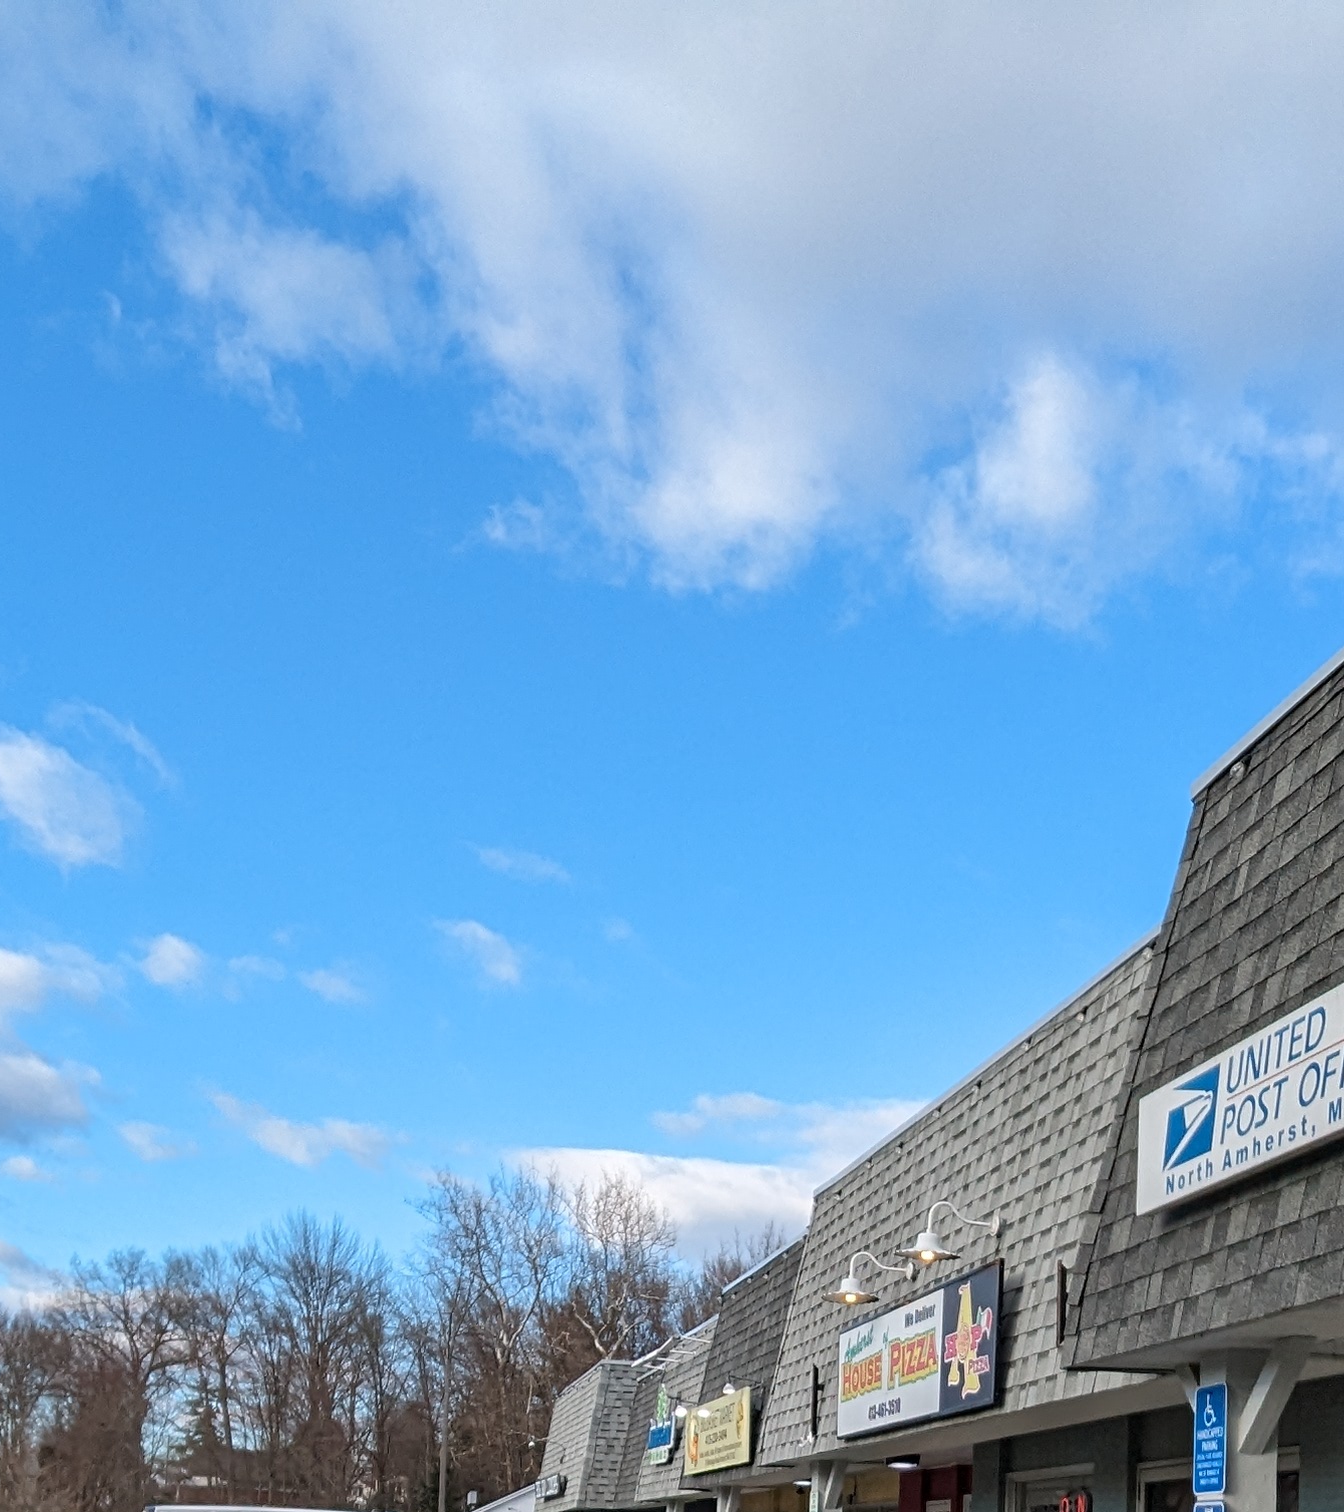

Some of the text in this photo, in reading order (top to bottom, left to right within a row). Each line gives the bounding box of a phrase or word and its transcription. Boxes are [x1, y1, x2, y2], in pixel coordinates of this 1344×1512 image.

[1225, 1006, 1326, 1093] UNITED
[1220, 1076, 1289, 1144] POST
[1165, 1159, 1214, 1195] North
[1222, 1119, 1316, 1172] Amherst,
[841, 1329, 938, 1400] HOUSE PIZZA
